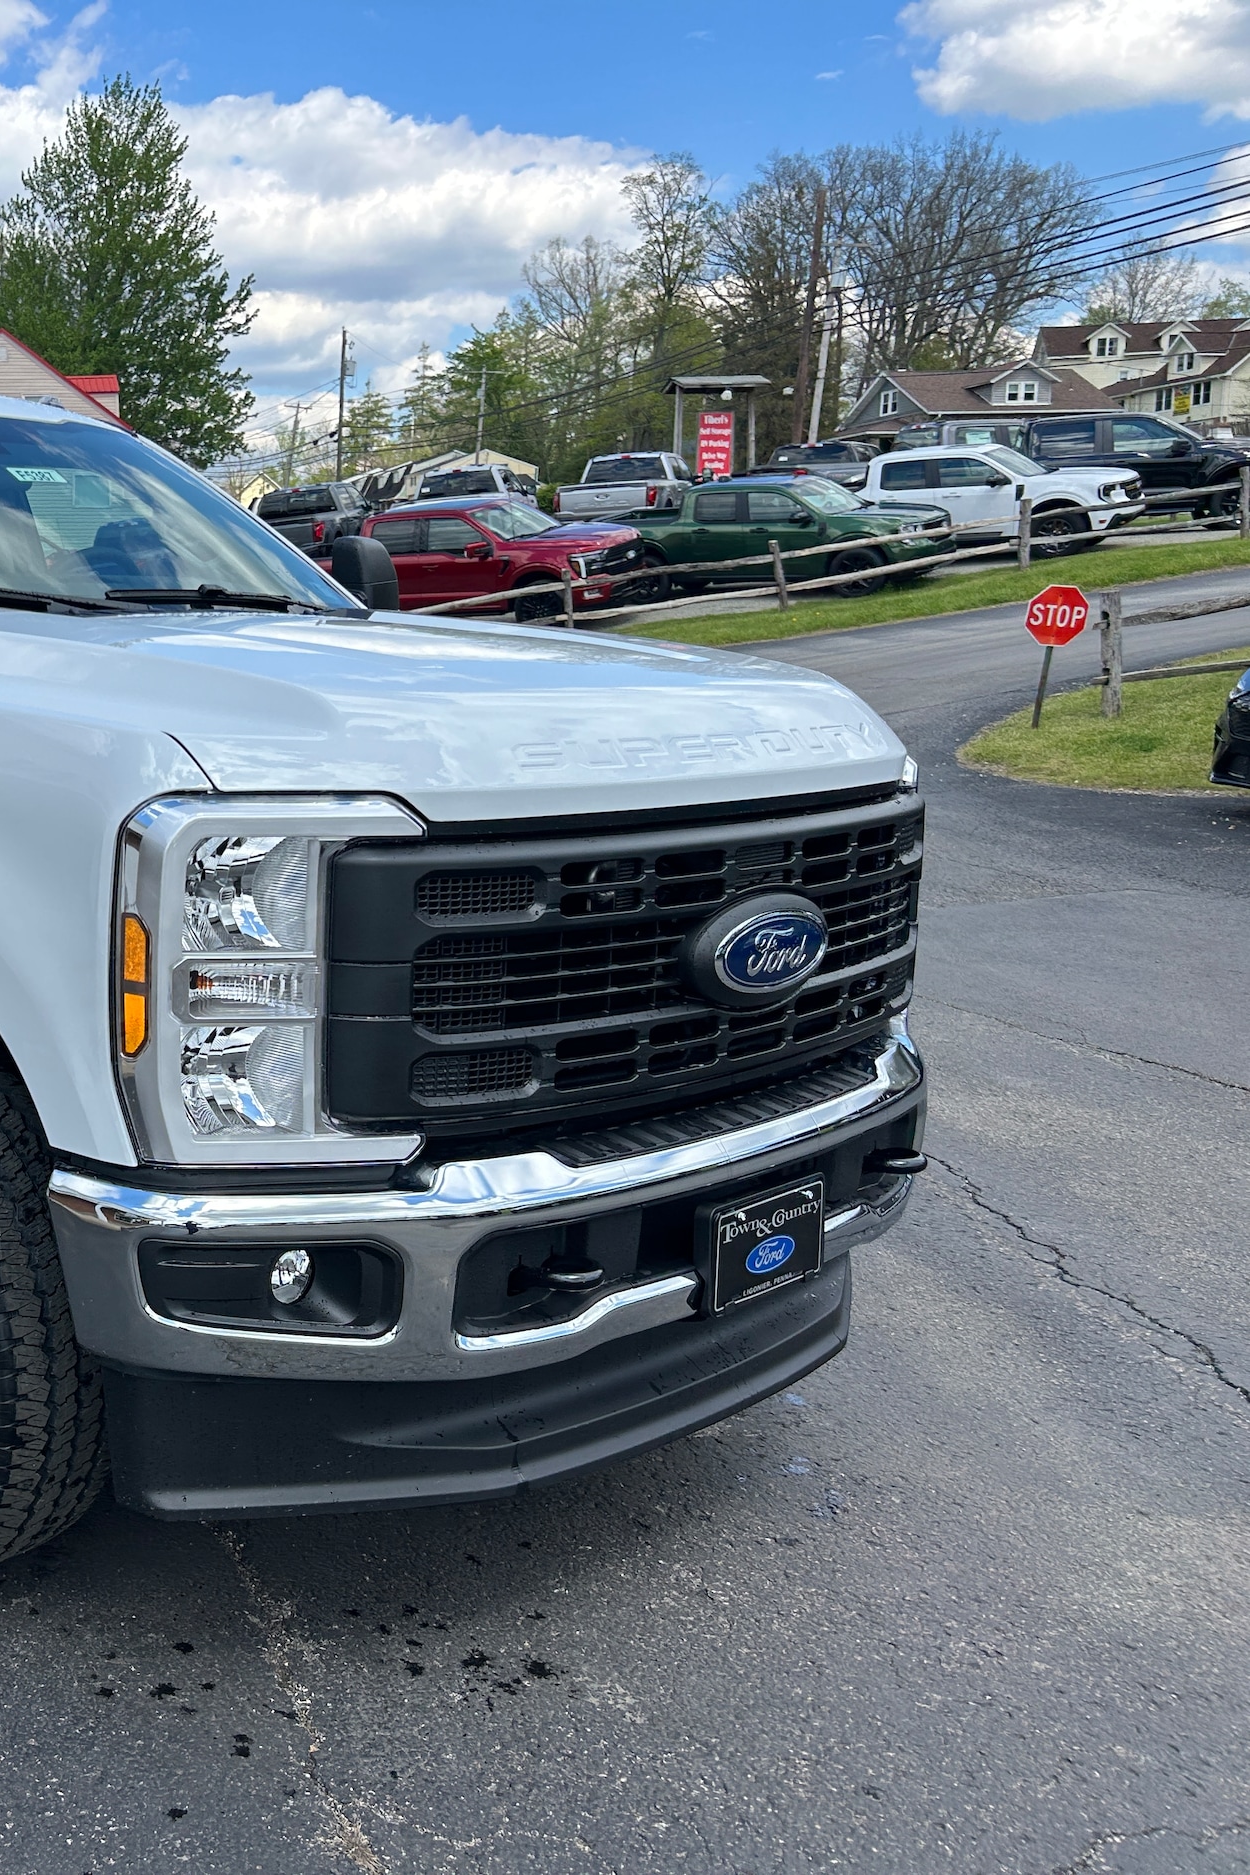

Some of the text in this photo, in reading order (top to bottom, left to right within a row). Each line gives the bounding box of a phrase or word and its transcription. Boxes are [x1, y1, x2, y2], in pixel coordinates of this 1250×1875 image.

[1029, 603, 1086, 628] STOP
[511, 722, 874, 772] SUPER DUTY
[746, 926, 808, 978] Ford
[754, 1241, 786, 1269] Ford
